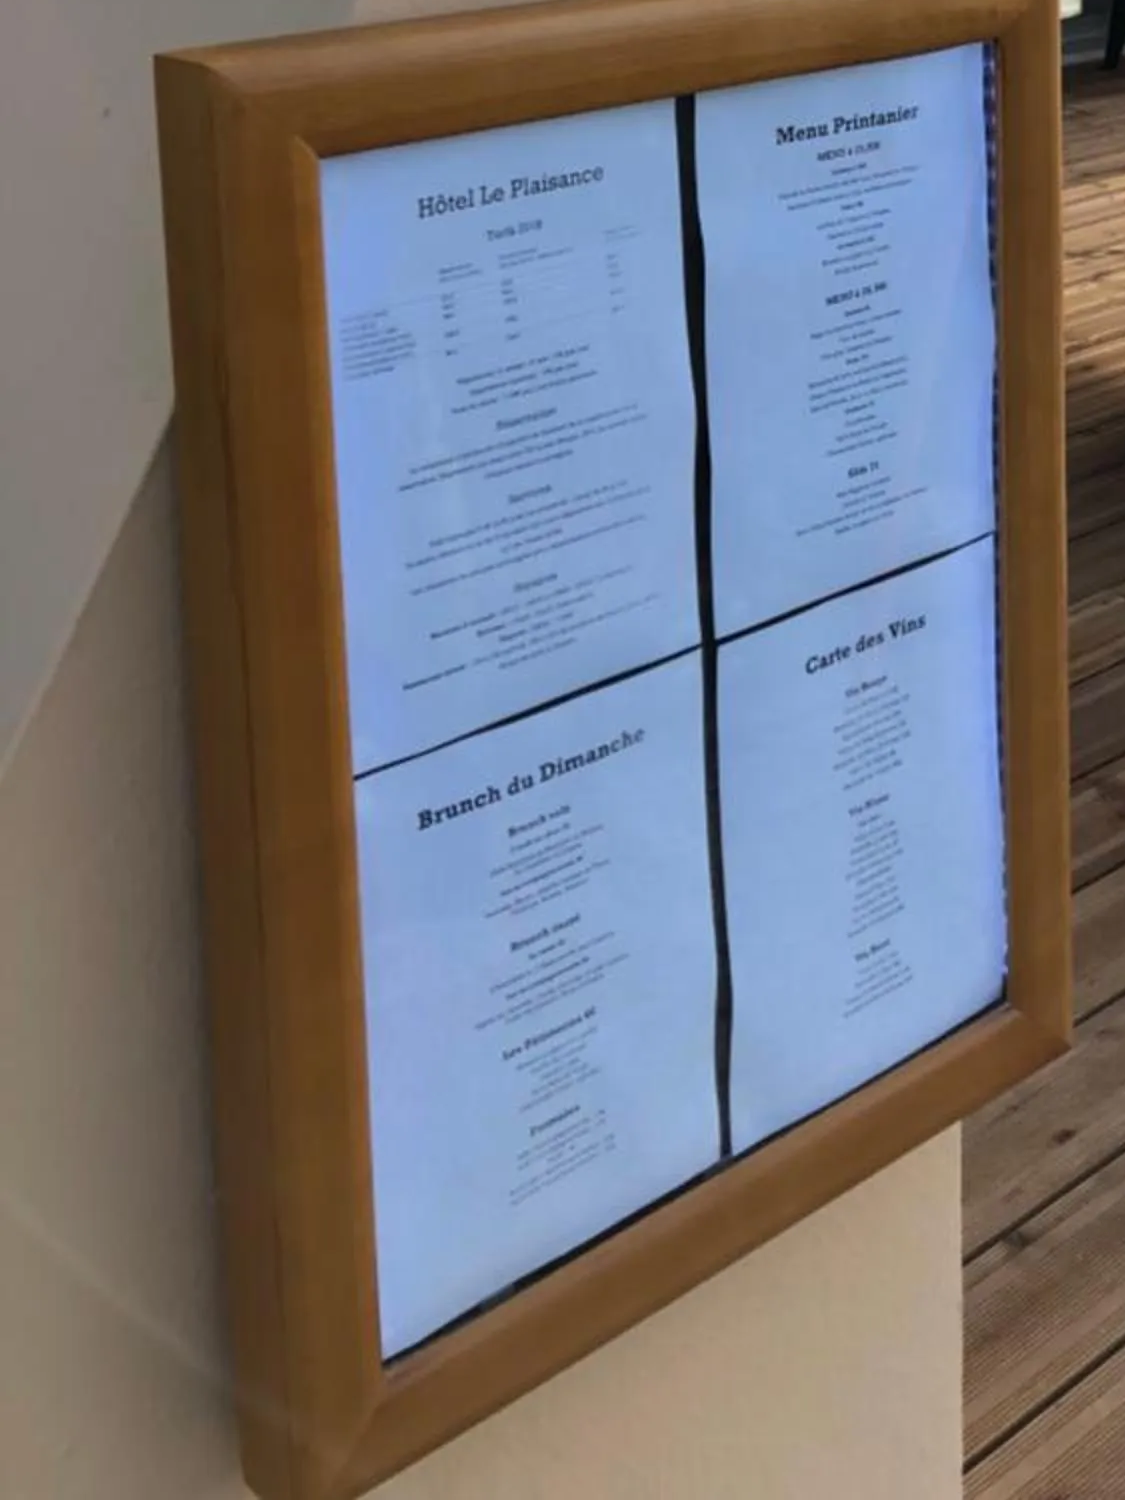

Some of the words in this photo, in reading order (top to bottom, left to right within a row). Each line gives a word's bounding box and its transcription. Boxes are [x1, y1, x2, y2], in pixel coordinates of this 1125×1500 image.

[776, 123, 829, 146] Menu
[832, 104, 919, 135] Printanier
[417, 188, 475, 220] Hôtel
[479, 185, 505, 206] Le
[511, 165, 605, 199] Plaisance
[805, 645, 851, 674] Carte
[855, 631, 885, 653] des
[888, 614, 927, 638] Vins
[417, 785, 502, 831] Brunch
[507, 775, 534, 797] du
[538, 728, 646, 784] Dimanche
